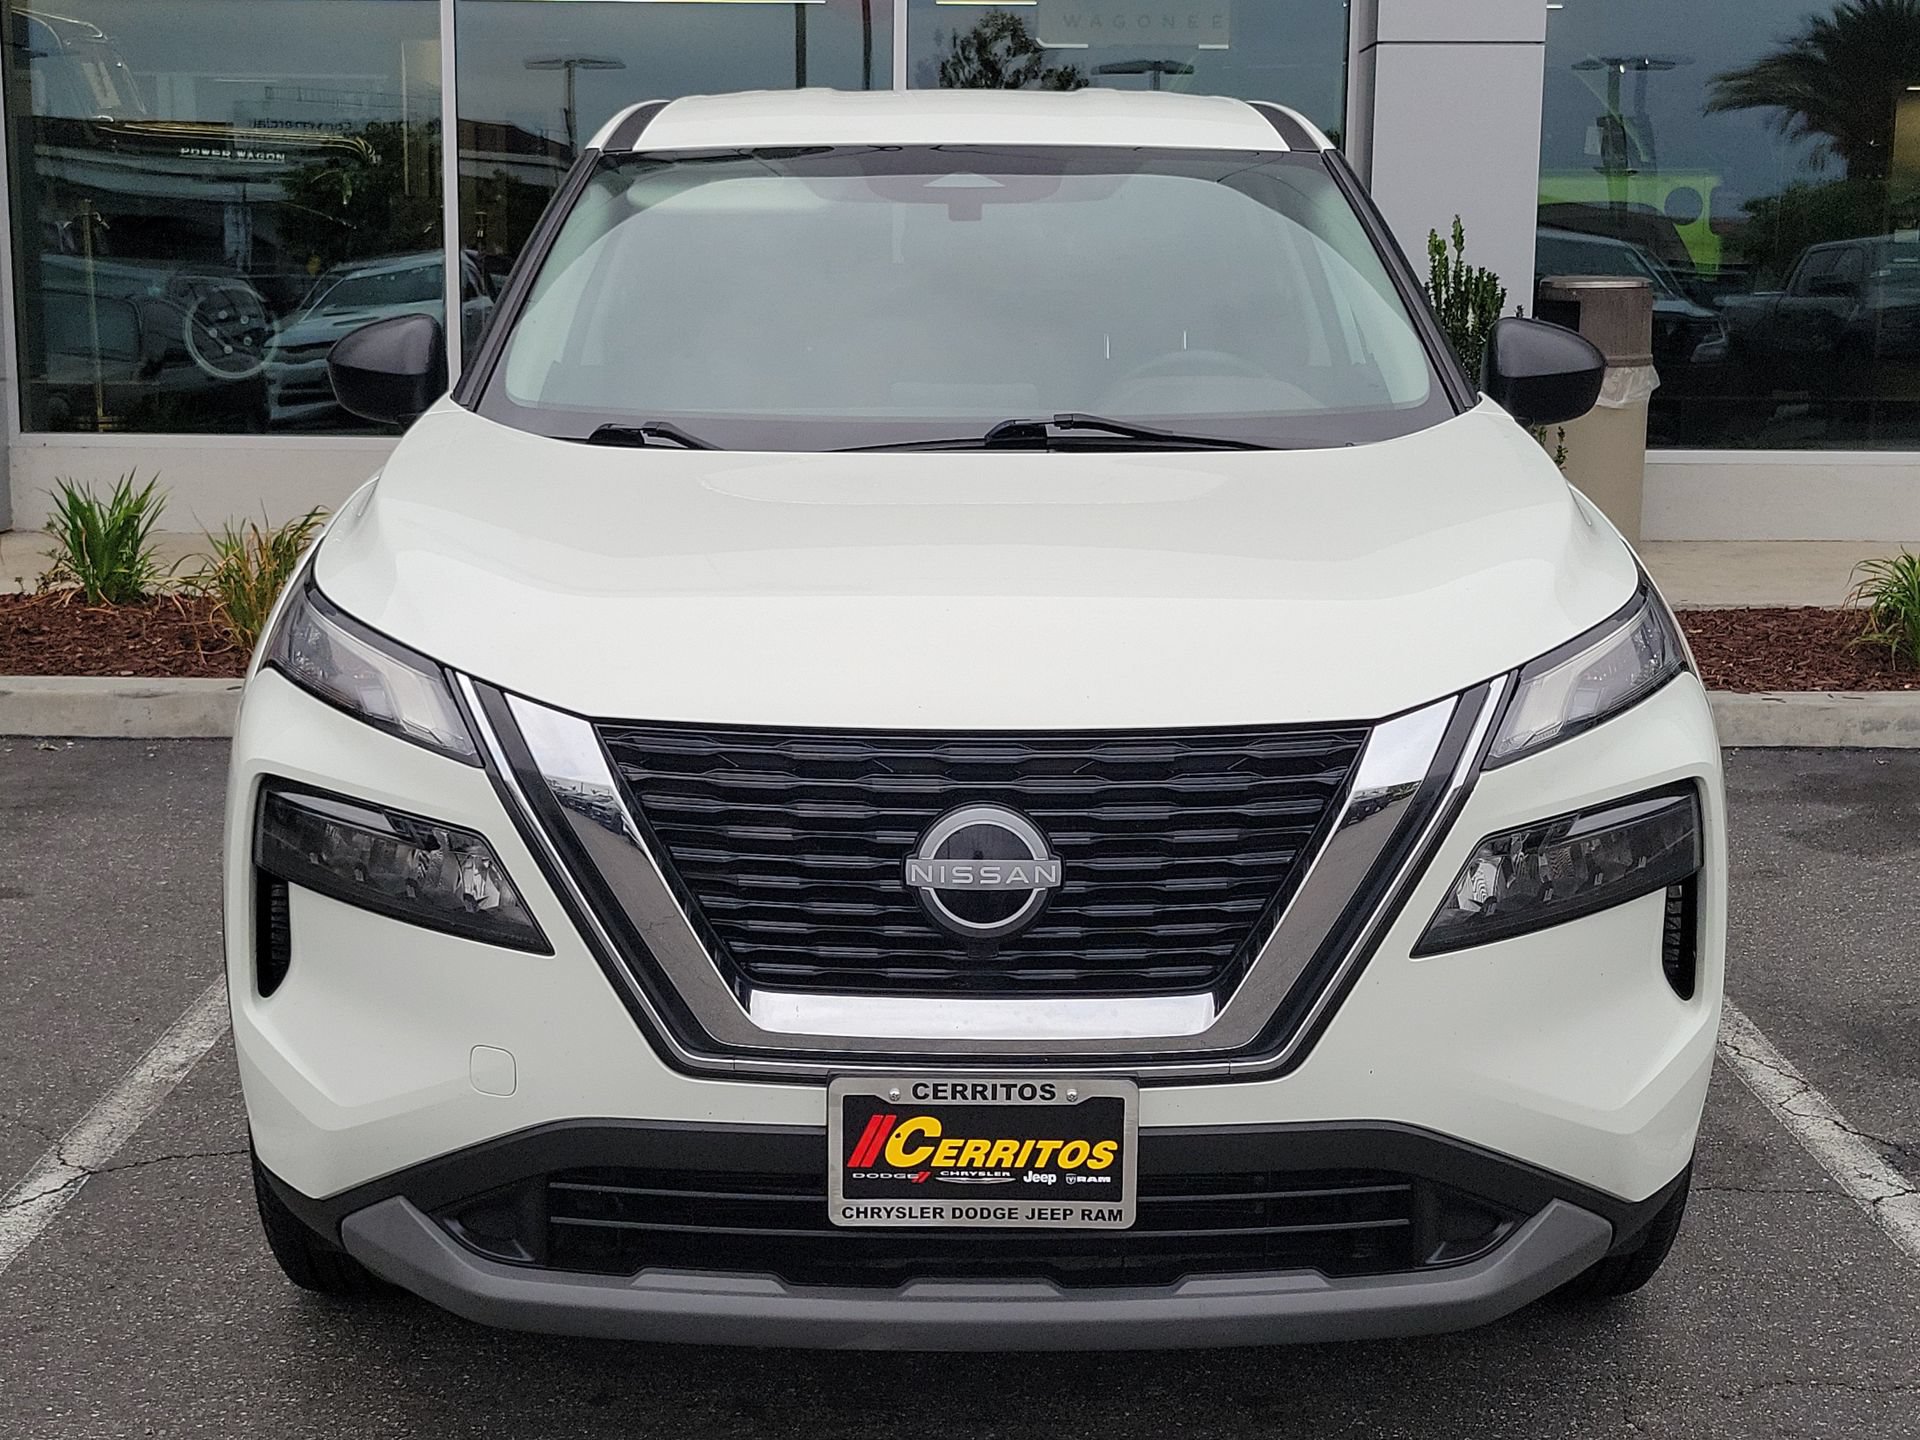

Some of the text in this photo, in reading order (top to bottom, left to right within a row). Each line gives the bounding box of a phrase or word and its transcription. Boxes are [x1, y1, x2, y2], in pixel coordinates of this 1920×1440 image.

[180, 147, 285, 161] POWER WAGON
[911, 865, 1056, 884] NISSAN
[911, 1082, 1056, 1101] CERRITOS
[852, 1172, 919, 1180] DODGE
[1023, 1170, 1057, 1185] Jeep
[841, 1206, 1123, 1221] CHRYSLER DODGE JEEP RAM
